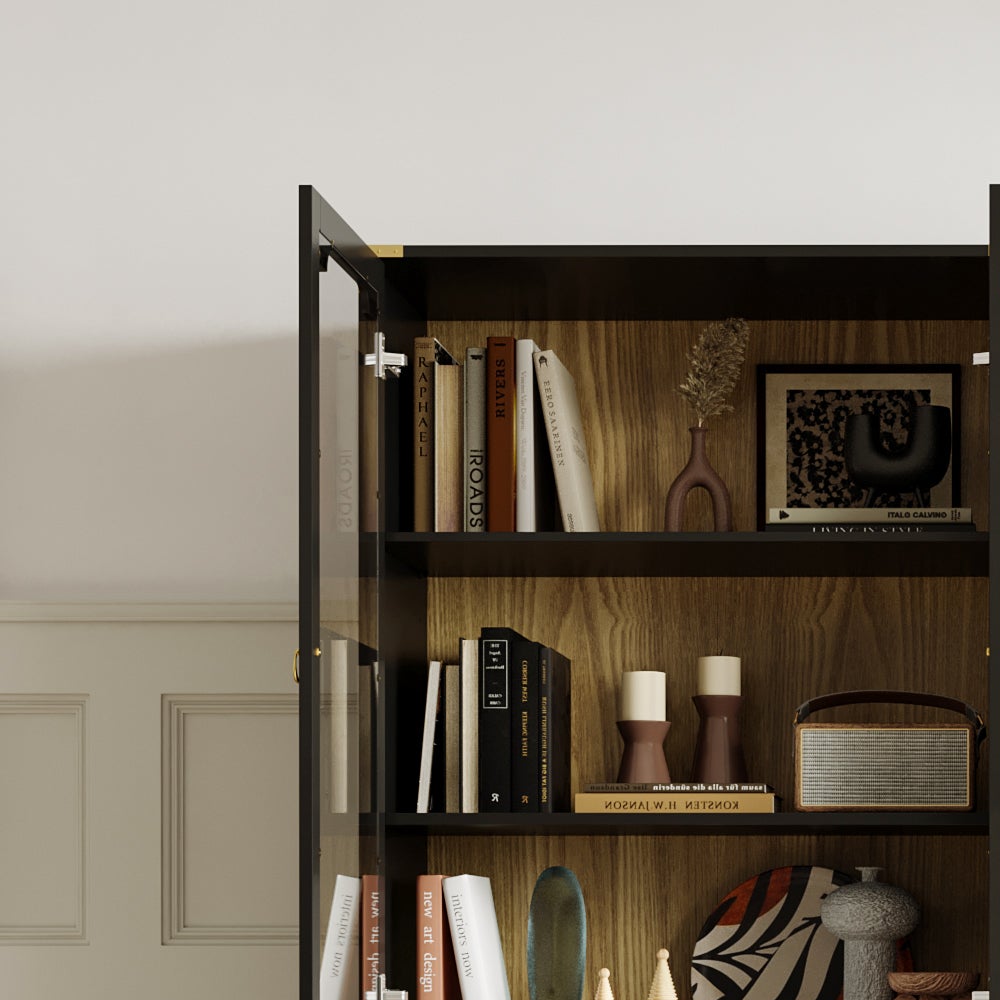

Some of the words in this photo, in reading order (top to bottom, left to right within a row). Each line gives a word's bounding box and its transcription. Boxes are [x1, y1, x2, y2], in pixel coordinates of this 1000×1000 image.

[418, 356, 429, 458] RAPHAEL
[495, 358, 506, 419] RIVERS
[543, 380, 555, 408] EERO
[548, 410, 565, 467] SAARINEN
[469, 454, 484, 528] ROADS
[887, 511, 911, 519] ITALO
[912, 511, 948, 519] CALVINO
[423, 891, 433, 918] new
[423, 926, 434, 945] art
[451, 894, 468, 947] interiors
[460, 951, 474, 978] now
[419, 952, 438, 993] design
